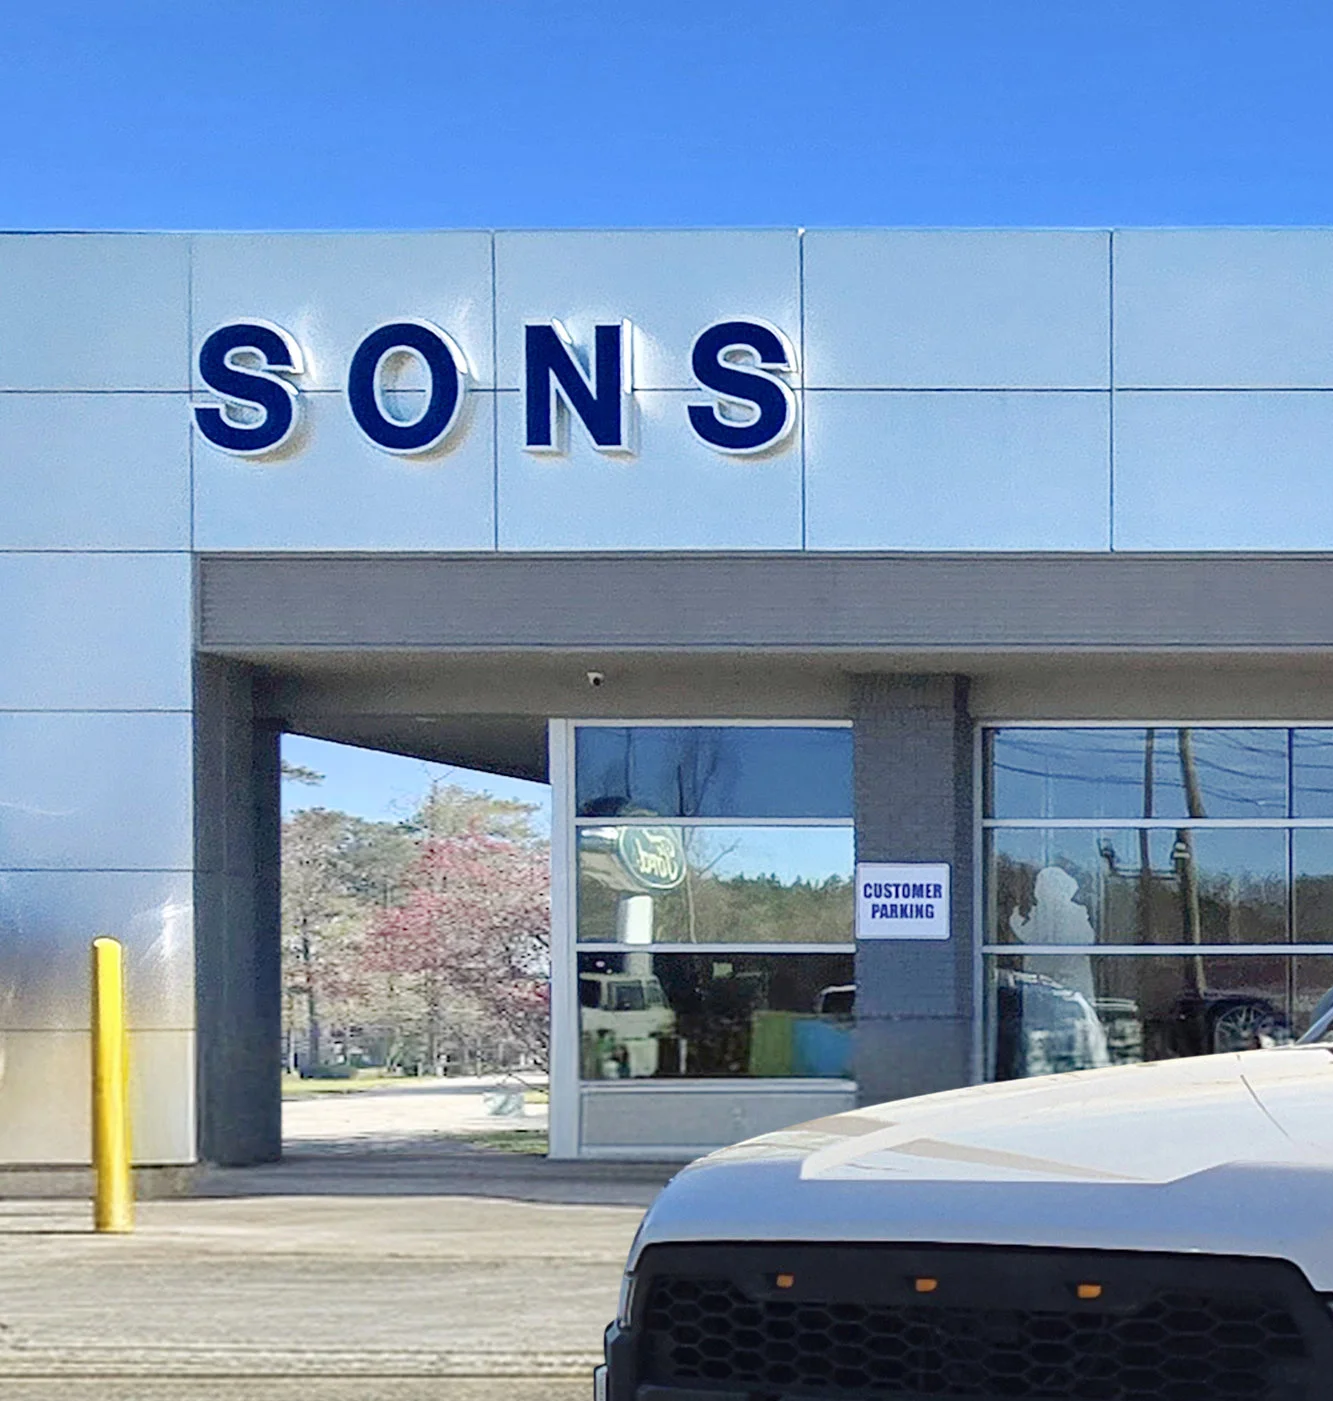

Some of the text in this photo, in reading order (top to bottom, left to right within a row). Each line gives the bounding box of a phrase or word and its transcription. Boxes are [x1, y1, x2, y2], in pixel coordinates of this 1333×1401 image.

[193, 318, 797, 455] SONS
[863, 883, 943, 899] CUSTOMER
[871, 904, 935, 919] PARKING
